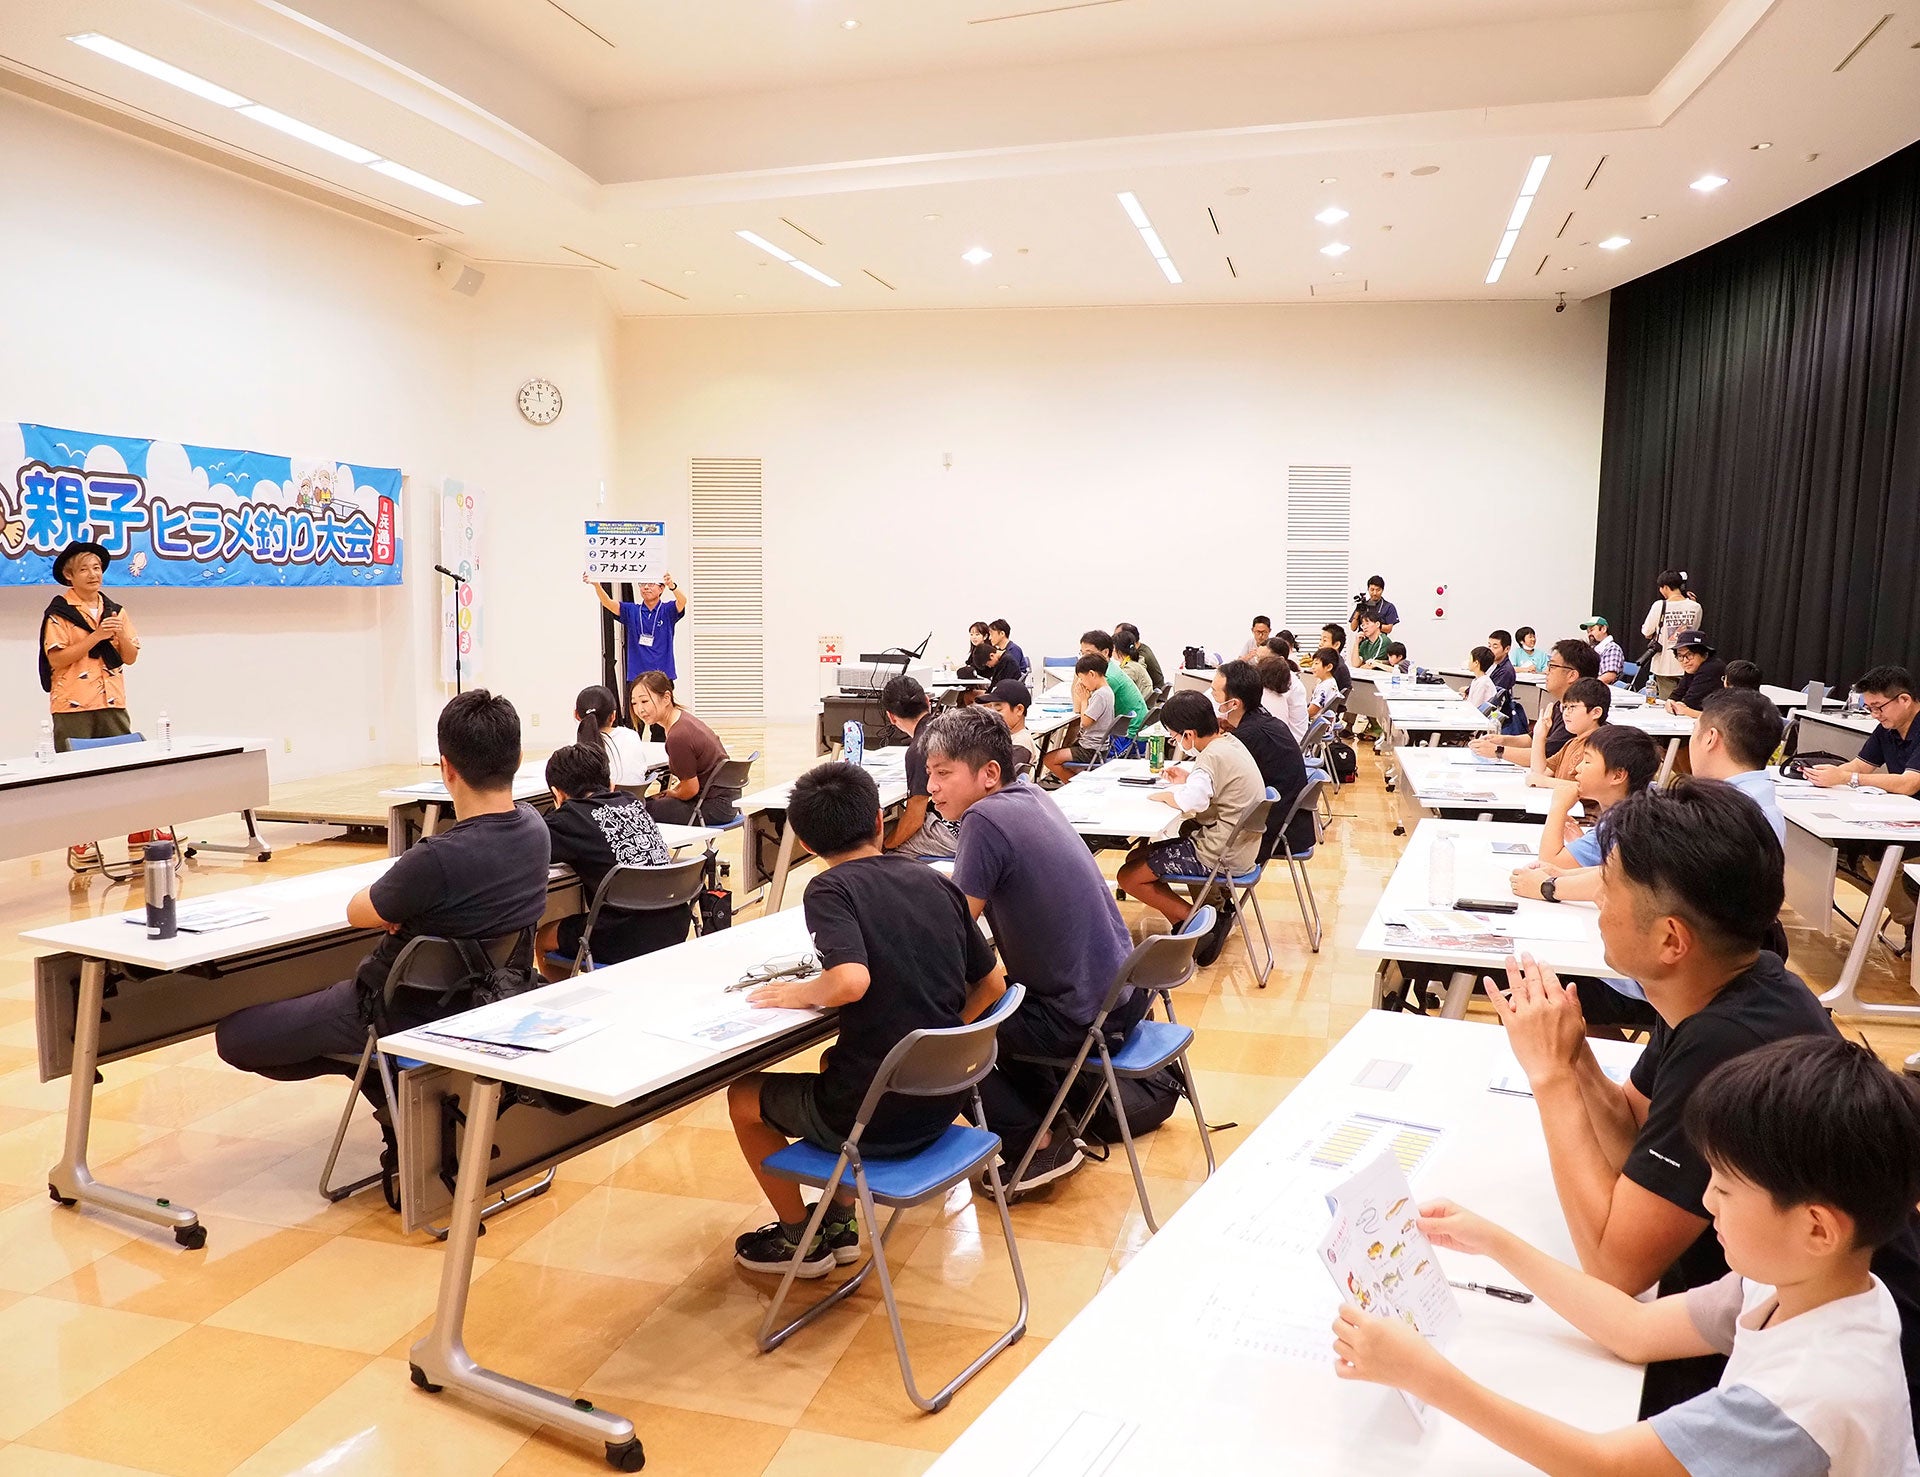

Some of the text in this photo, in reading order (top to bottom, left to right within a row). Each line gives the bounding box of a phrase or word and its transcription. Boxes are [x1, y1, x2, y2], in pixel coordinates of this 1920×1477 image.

[599, 549, 646, 560] アオイソメ
